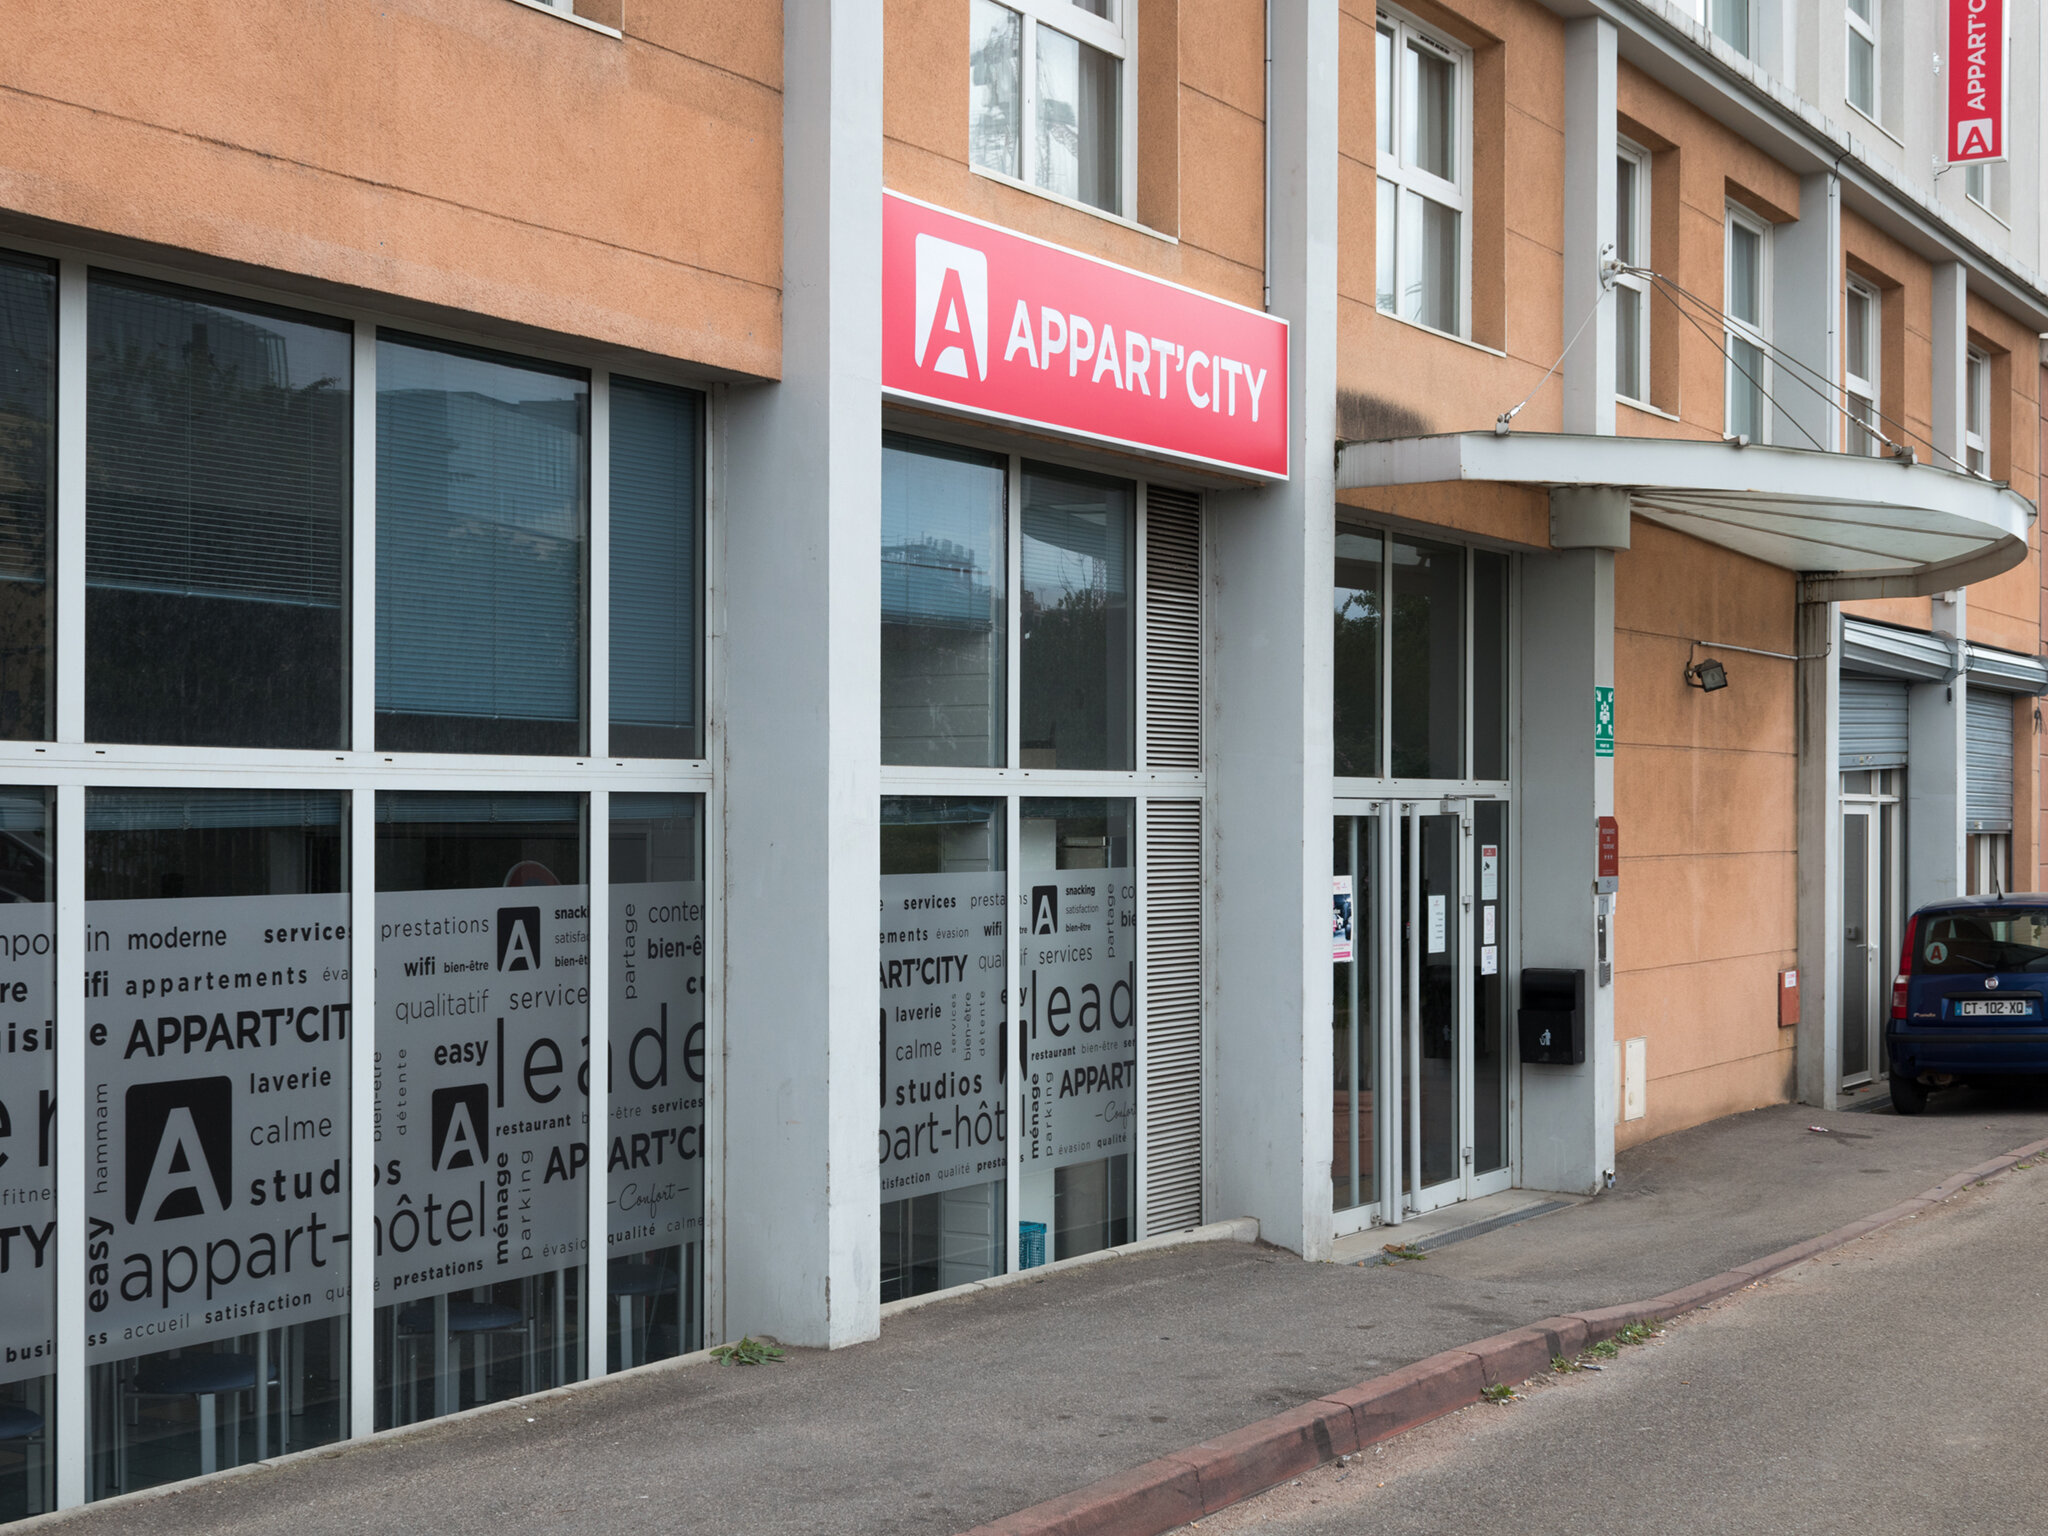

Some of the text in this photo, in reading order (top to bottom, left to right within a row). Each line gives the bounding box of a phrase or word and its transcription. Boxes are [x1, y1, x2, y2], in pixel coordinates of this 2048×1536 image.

[1003, 299, 1267, 423] APPART'CITY
[904, 894, 957, 911] services
[1065, 884, 1096, 896] snacking
[1065, 903, 1099, 914] satisfaction
[127, 926, 227, 951] moderne
[381, 916, 489, 942] prestations
[936, 928, 970, 940] évasion
[983, 921, 1003, 937] wifi
[404, 956, 489, 978] wifi bien-être
[624, 903, 638, 1000] partage
[1039, 945, 1093, 966] services
[125, 966, 307, 998] appartements
[395, 989, 489, 1025] qualitatif
[895, 1002, 942, 1022] laverie
[434, 1040, 489, 1067] easy
[896, 1039, 942, 1062] calme
[1031, 1045, 1076, 1061] restaurant
[250, 1067, 331, 1094] laverie
[397, 1049, 407, 1136] détente
[896, 1071, 983, 1106] studios
[496, 1114, 571, 1137] restaurant
[1029, 1073, 1041, 1160] ménage
[1044, 1072, 1054, 1157] parking
[93, 1083, 108, 1194] hammam
[250, 1116, 332, 1146] calme
[937, 1162, 971, 1181] qualité
[1058, 1142, 1091, 1155] évasion
[1097, 1132, 1127, 1149] qualité
[493, 1151, 511, 1265] ménage
[519, 1150, 533, 1260] parking
[608, 1223, 656, 1245] qualité
[88, 1216, 115, 1313] easy
[123, 1312, 190, 1341] accueil
[205, 1292, 312, 1325] satisfaction
[393, 1259, 484, 1291] prestations
